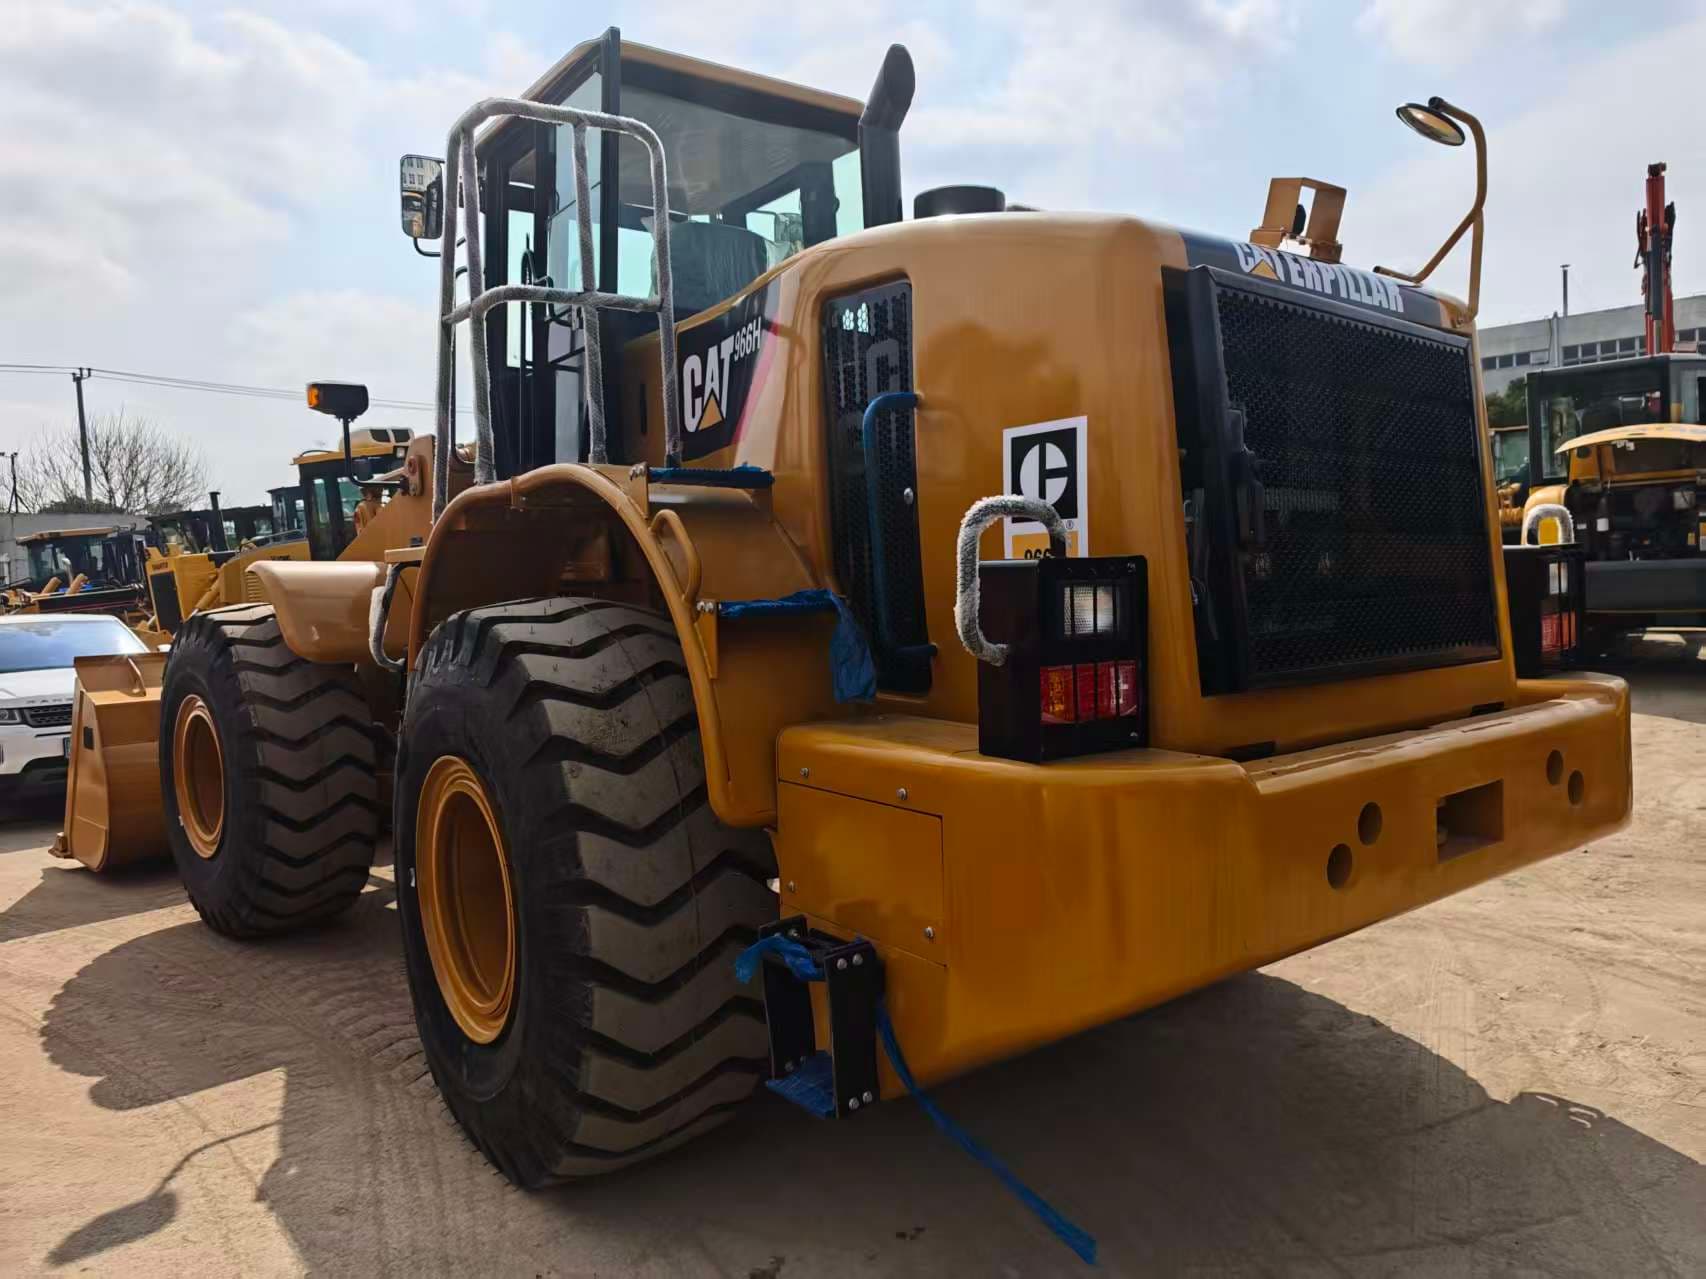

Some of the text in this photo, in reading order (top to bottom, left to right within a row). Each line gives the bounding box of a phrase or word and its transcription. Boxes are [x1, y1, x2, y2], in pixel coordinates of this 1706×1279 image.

[1232, 242, 1404, 313] CATERPILLAR
[682, 316, 762, 433] CAT 966H
